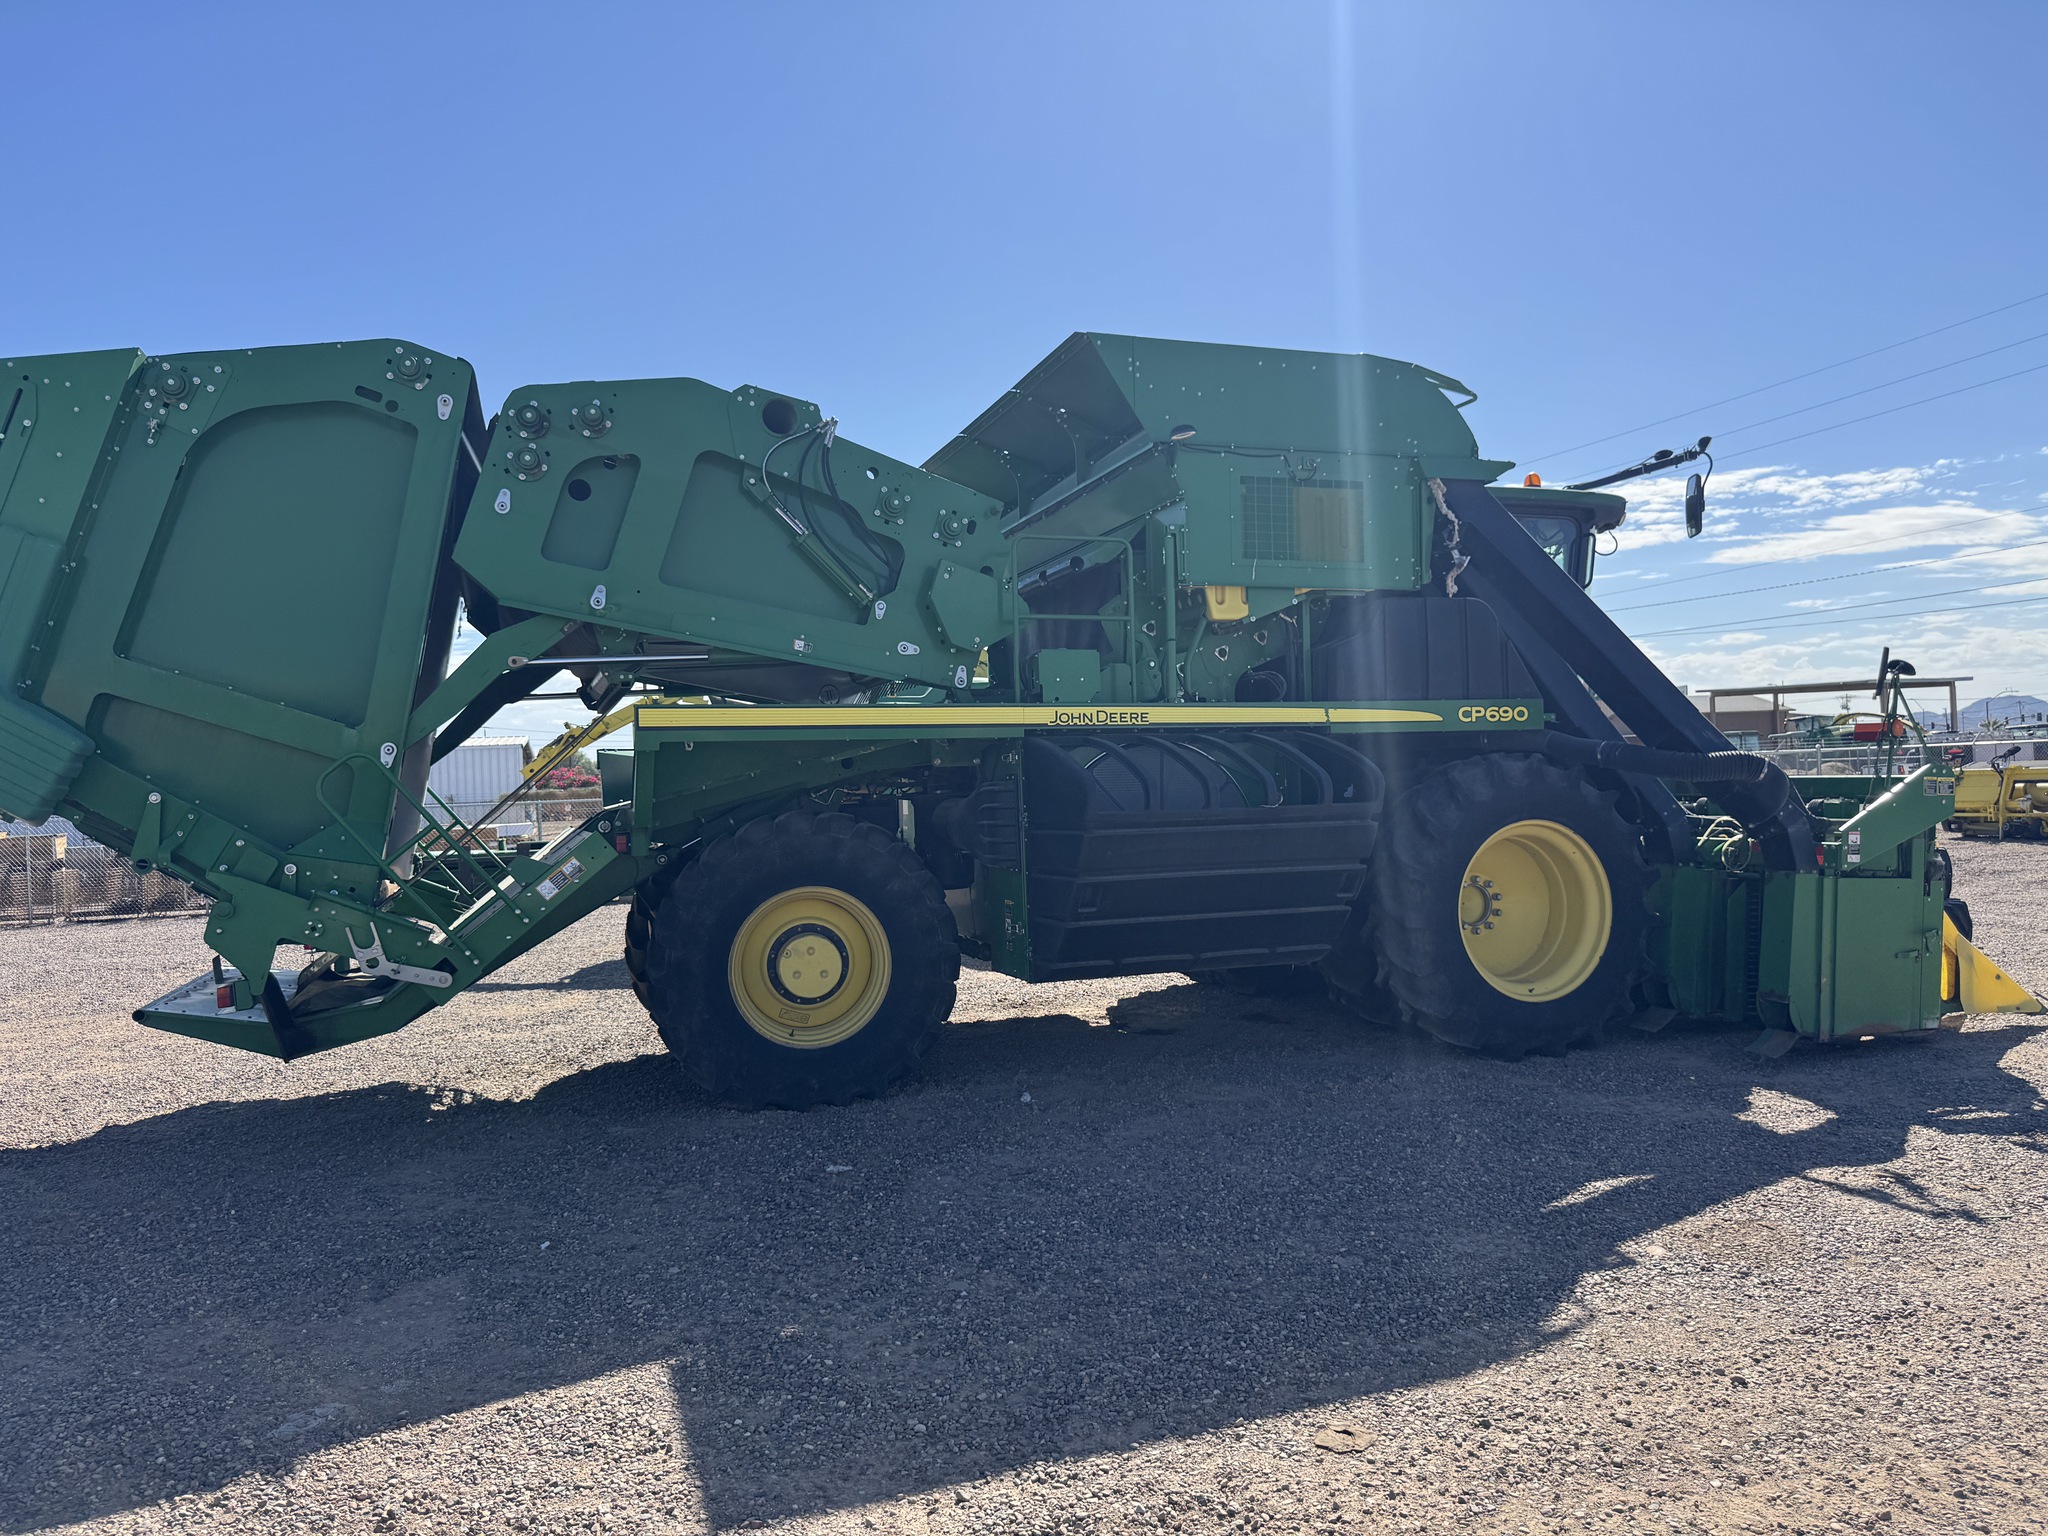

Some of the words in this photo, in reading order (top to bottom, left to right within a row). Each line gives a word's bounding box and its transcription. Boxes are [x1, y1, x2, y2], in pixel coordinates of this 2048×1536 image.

[1049, 710, 1093, 724] JOHN
[1096, 710, 1150, 723] DEERE
[1458, 706, 1529, 722] CP690
